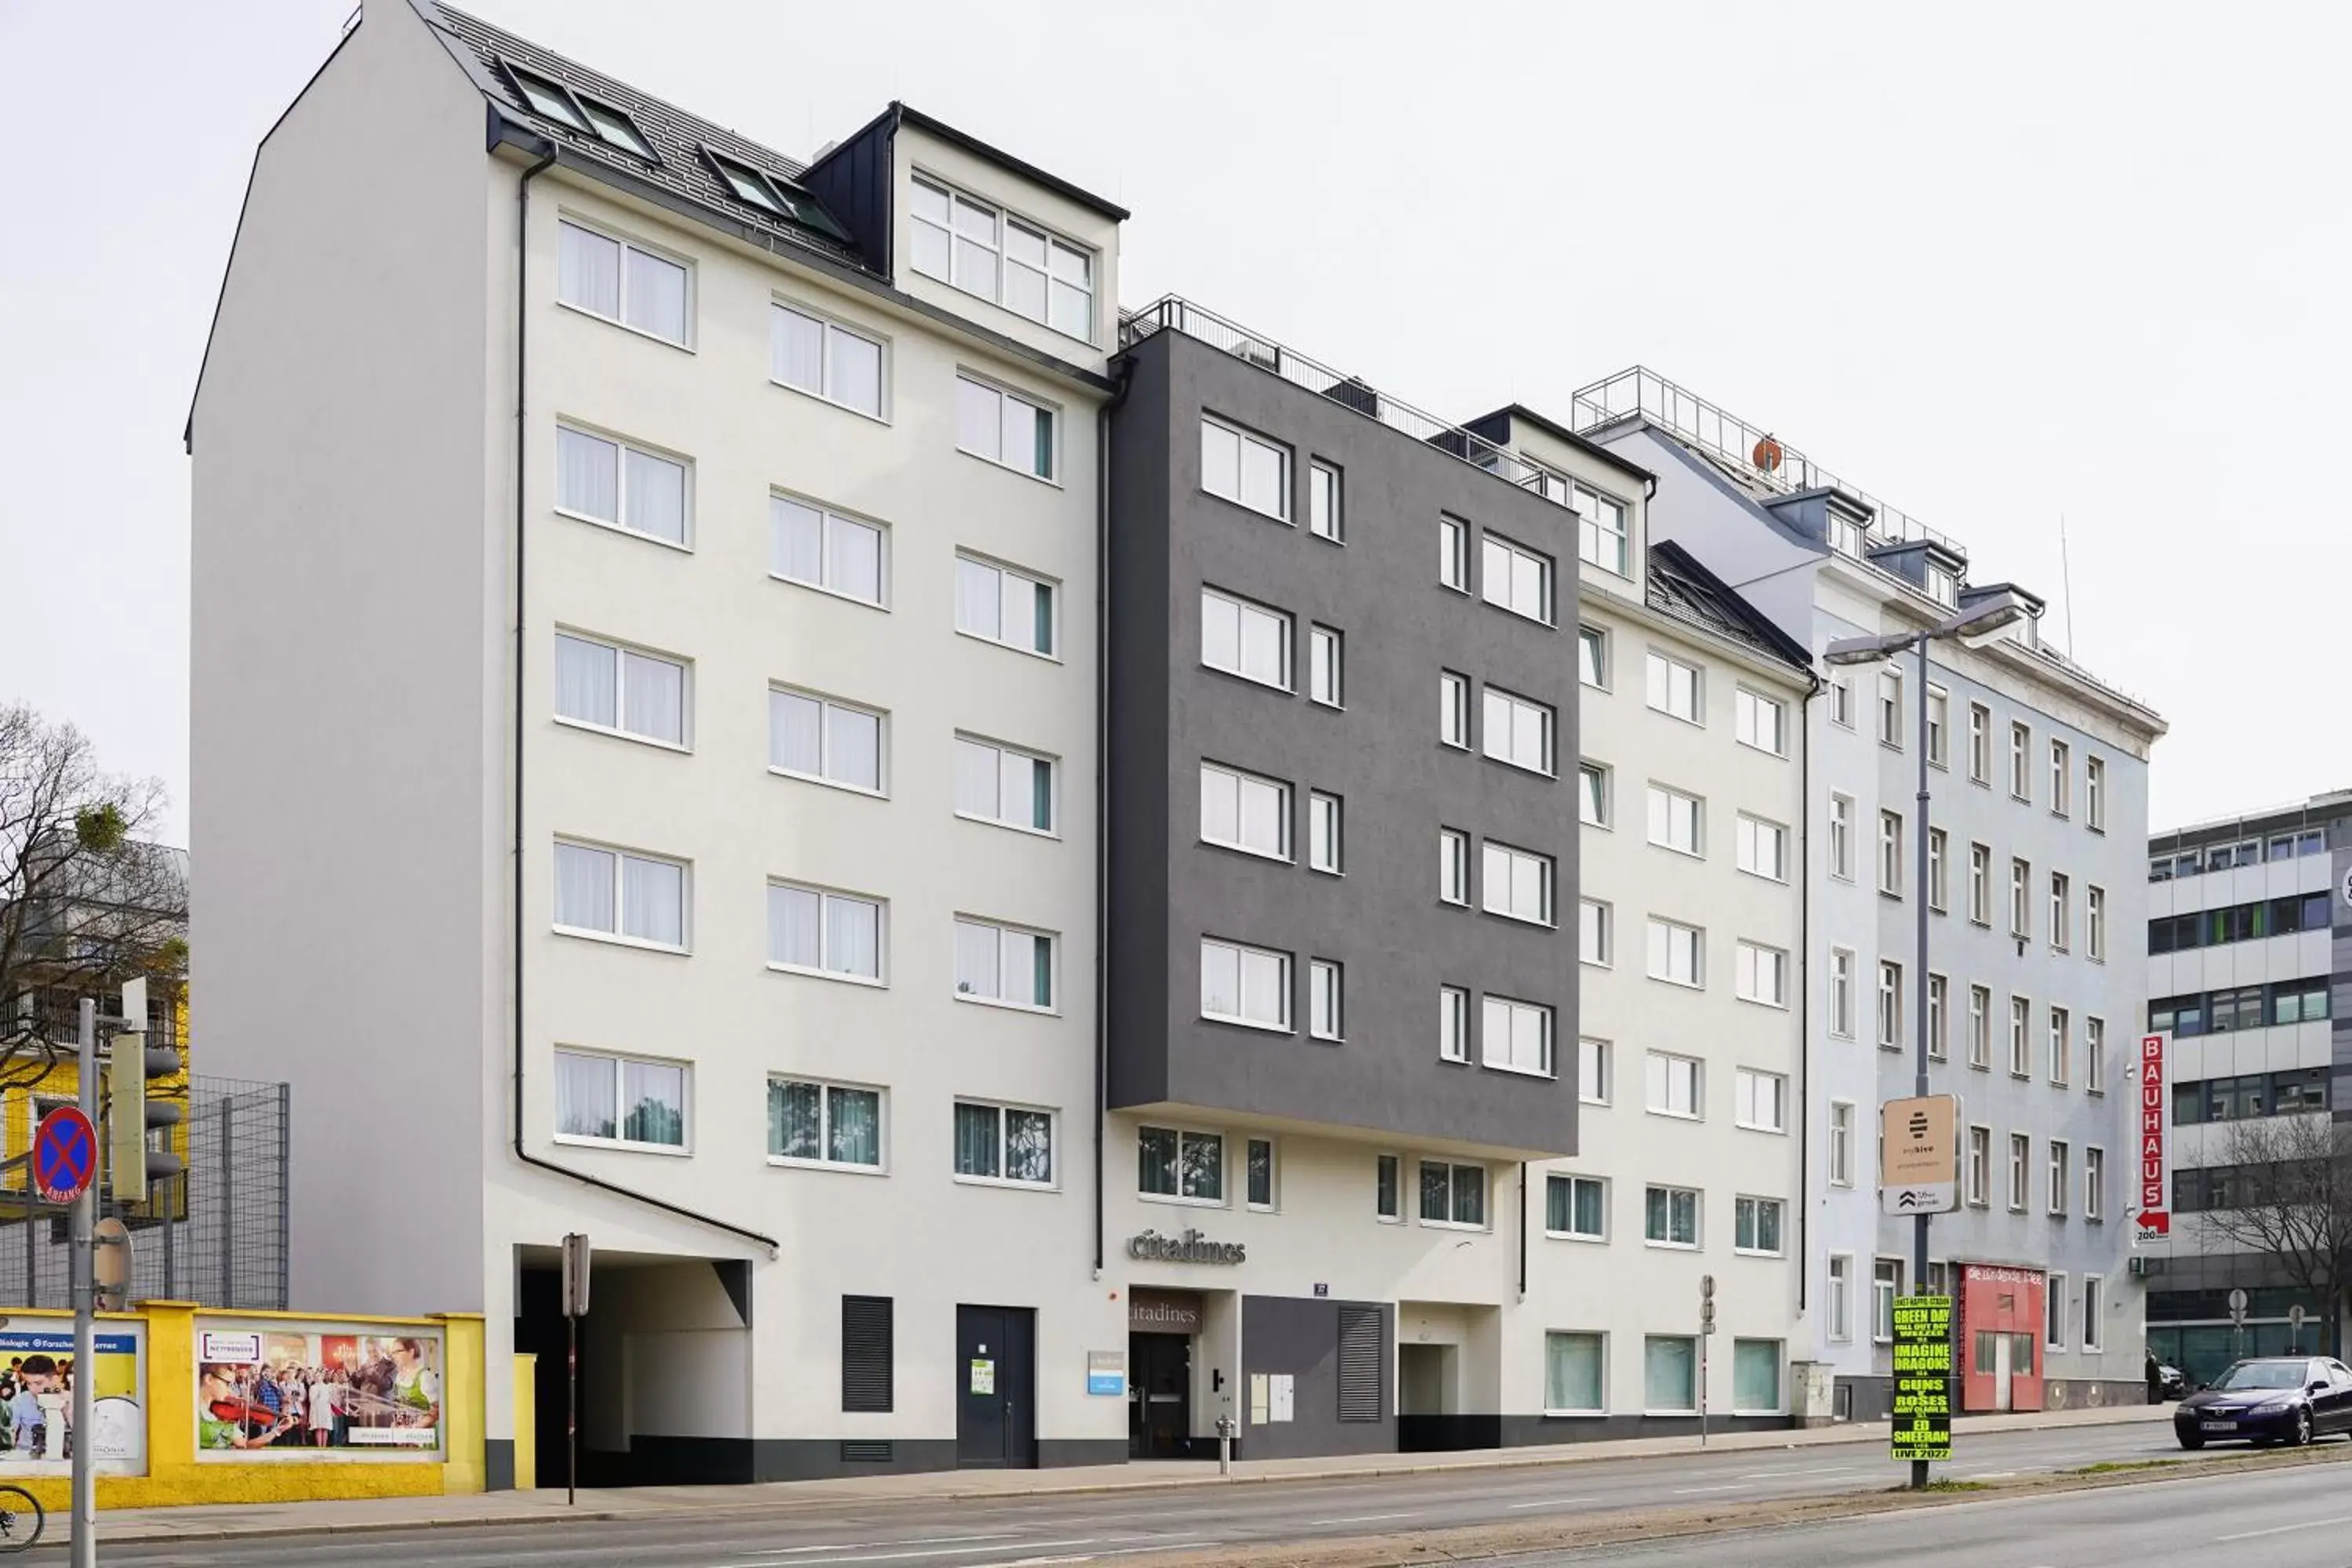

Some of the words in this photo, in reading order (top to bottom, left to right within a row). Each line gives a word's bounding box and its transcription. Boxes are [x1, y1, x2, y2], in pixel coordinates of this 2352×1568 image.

[2143, 1039, 2160, 1204] BAUHAUS
[46, 1184, 82, 1202] ANFANG
[2137, 1230, 2155, 1241] 200
[1894, 1310, 1928, 1323] GREEN
[1930, 1309, 1950, 1322] DAY
[1894, 1344, 1951, 1357] IMAGINE
[1894, 1357, 1951, 1370] DRAGONS
[1900, 1379, 1944, 1391] GUNS
[1896, 1396, 1947, 1406] ROSES
[1914, 1420, 1929, 1431] ED
[1893, 1431, 1949, 1443] SHEERAN
[1895, 1450, 1918, 1458] LIVE
[1919, 1449, 1949, 1458] 2022
